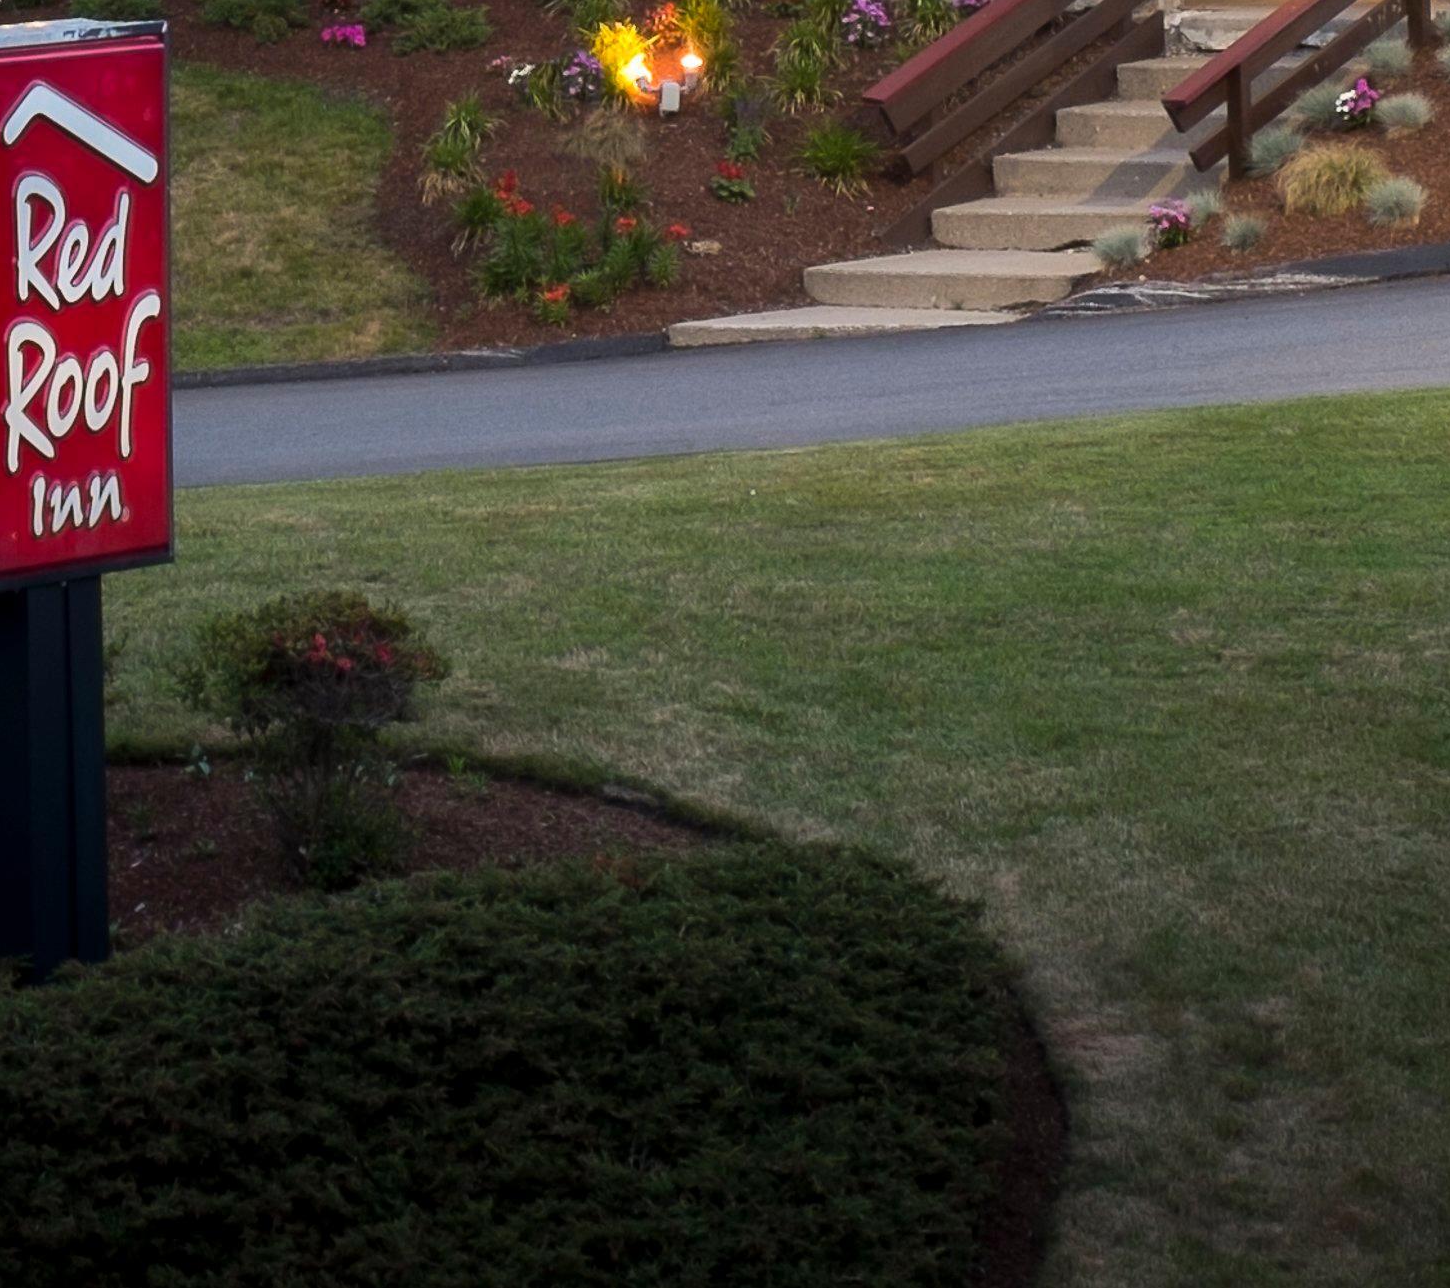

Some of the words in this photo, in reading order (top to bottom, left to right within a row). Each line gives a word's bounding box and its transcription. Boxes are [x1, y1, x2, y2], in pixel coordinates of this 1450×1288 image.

[13, 173, 130, 311] Red
[4, 290, 161, 474] Roof
[32, 474, 123, 537] Inn
